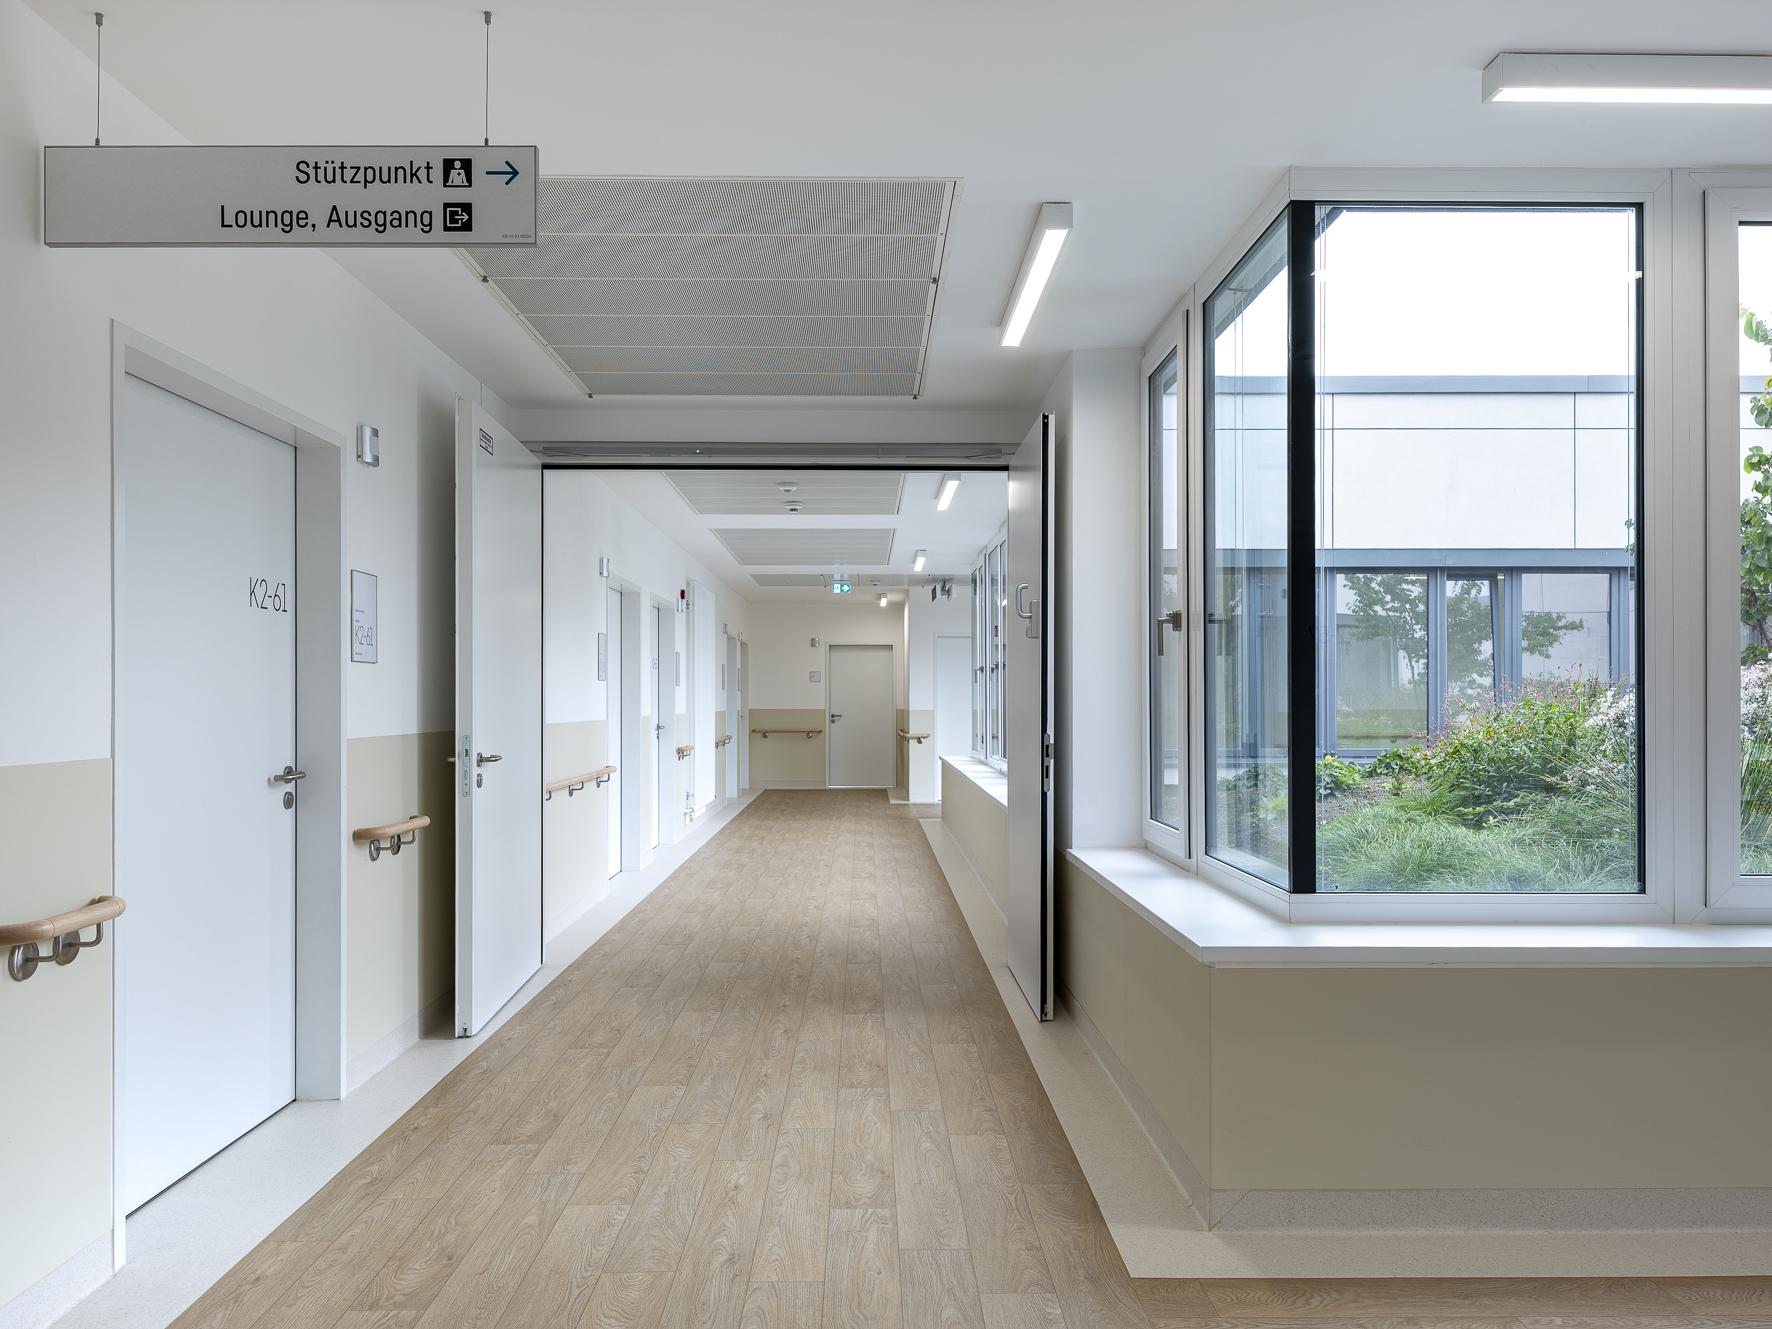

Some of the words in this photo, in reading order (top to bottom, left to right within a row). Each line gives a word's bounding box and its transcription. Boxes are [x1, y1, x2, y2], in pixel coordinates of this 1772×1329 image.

[295, 159, 434, 189] Stützpunkt
[220, 204, 317, 234] Lounge,
[325, 204, 433, 234] Ausgang
[249, 576, 288, 613] K2-61
[354, 625, 374, 647] K2-61
